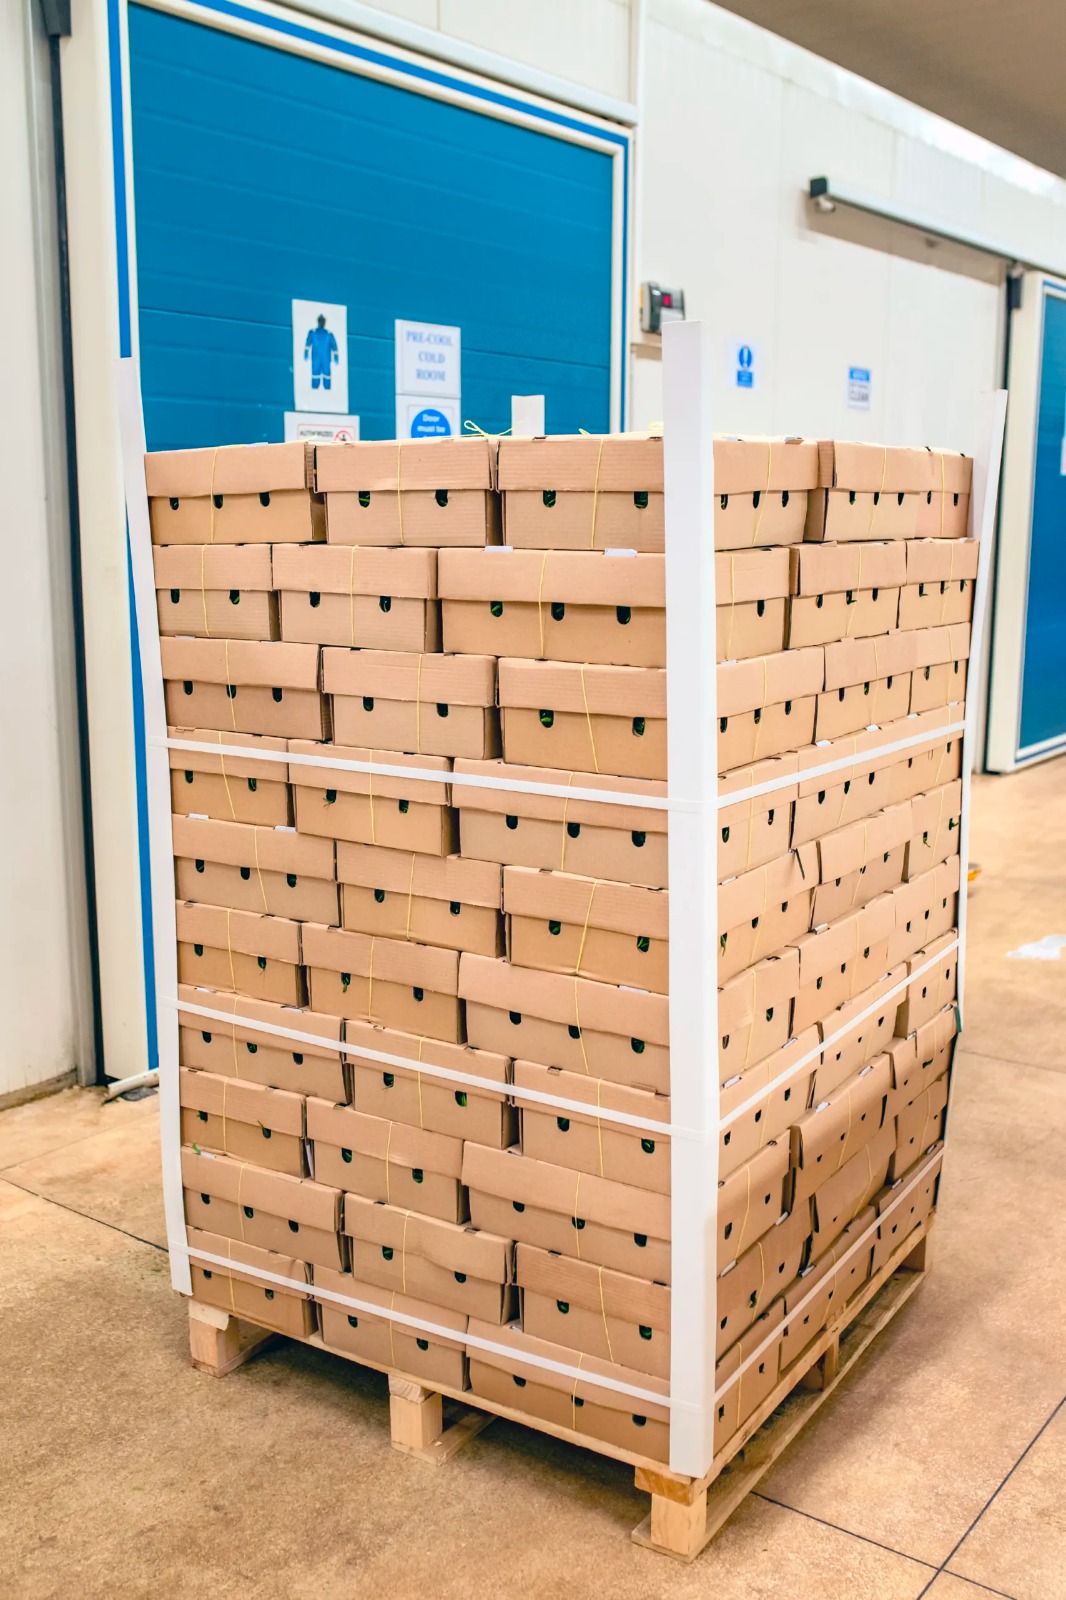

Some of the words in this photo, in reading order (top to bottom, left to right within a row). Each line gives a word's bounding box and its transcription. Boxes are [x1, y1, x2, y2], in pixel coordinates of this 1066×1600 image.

[406, 331, 454, 346] PRE-COOL
[418, 351, 446, 364] COLD
[416, 369, 446, 381] ROOM
[422, 413, 440, 422] Door
